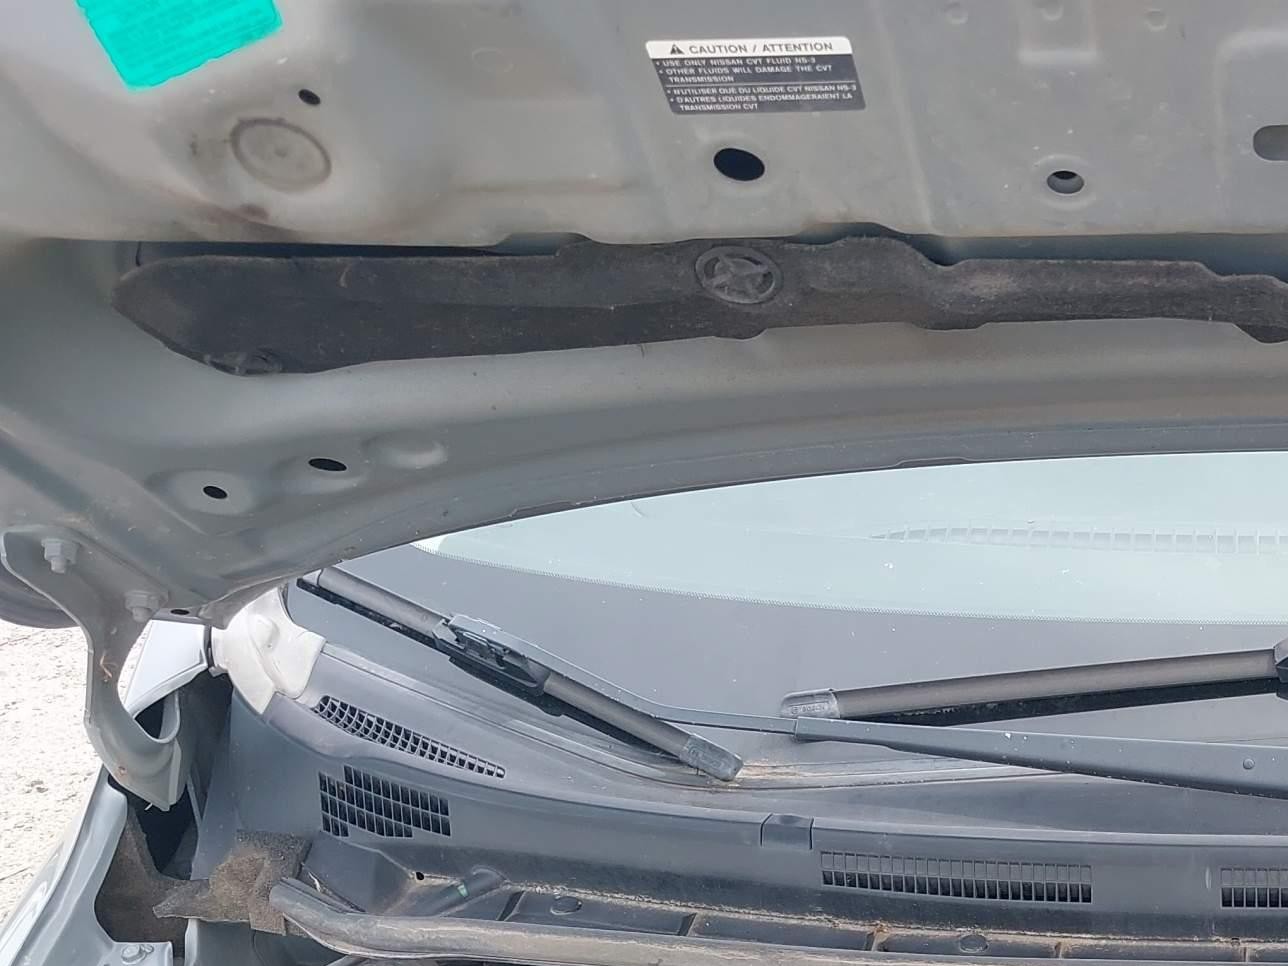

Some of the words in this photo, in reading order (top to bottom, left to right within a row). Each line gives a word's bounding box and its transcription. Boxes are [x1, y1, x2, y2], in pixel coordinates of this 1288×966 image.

[688, 44, 748, 54] CAUTION
[763, 42, 833, 52] ATTENTION
[710, 58, 743, 66] NISSAN
[732, 66, 752, 74] WILL
[816, 64, 832, 72] CVT
